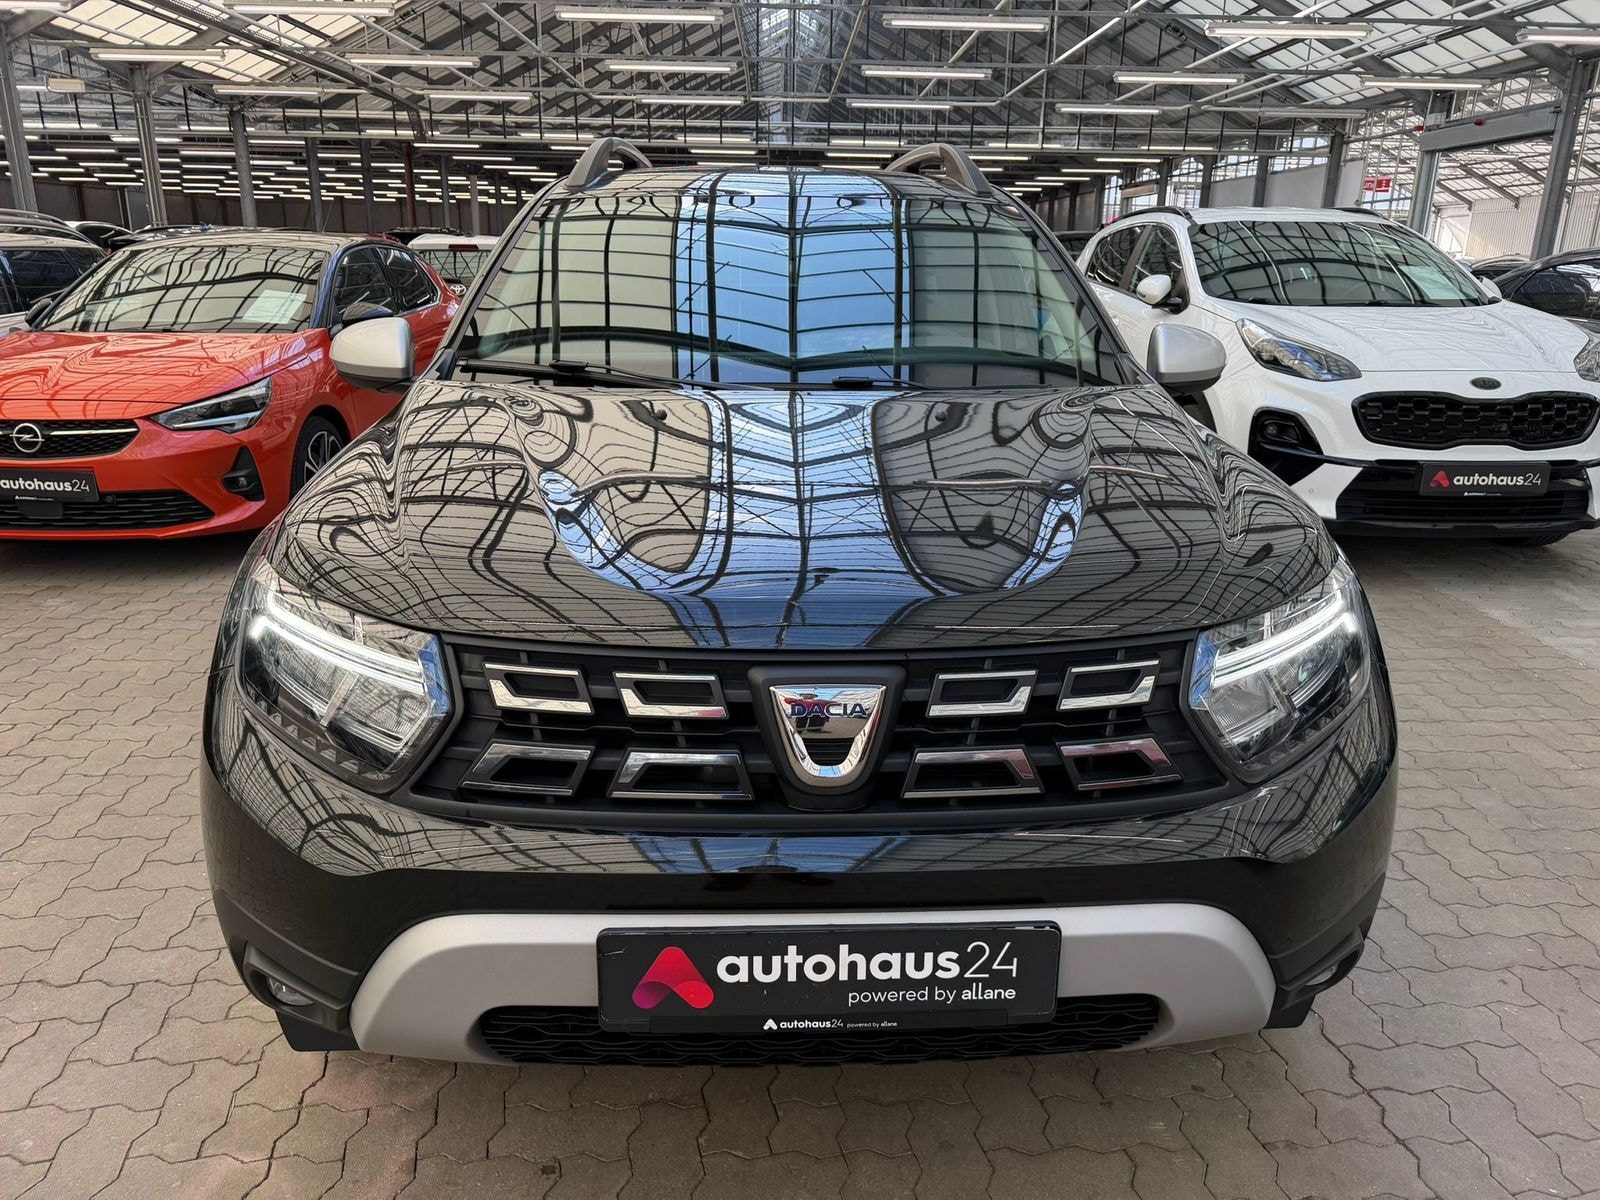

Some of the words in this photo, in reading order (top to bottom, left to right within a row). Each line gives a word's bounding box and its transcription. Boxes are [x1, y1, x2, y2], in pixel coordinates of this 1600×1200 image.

[0, 477, 90, 492] autohaus24
[1453, 472, 1541, 486] autohaus24
[790, 702, 868, 718] DACIA
[716, 942, 1018, 984] autohaus24
[848, 986, 929, 1007] powered
[934, 986, 957, 1004] by
[961, 982, 1017, 1000] allane
[780, 1018, 844, 1029] autohaus24
